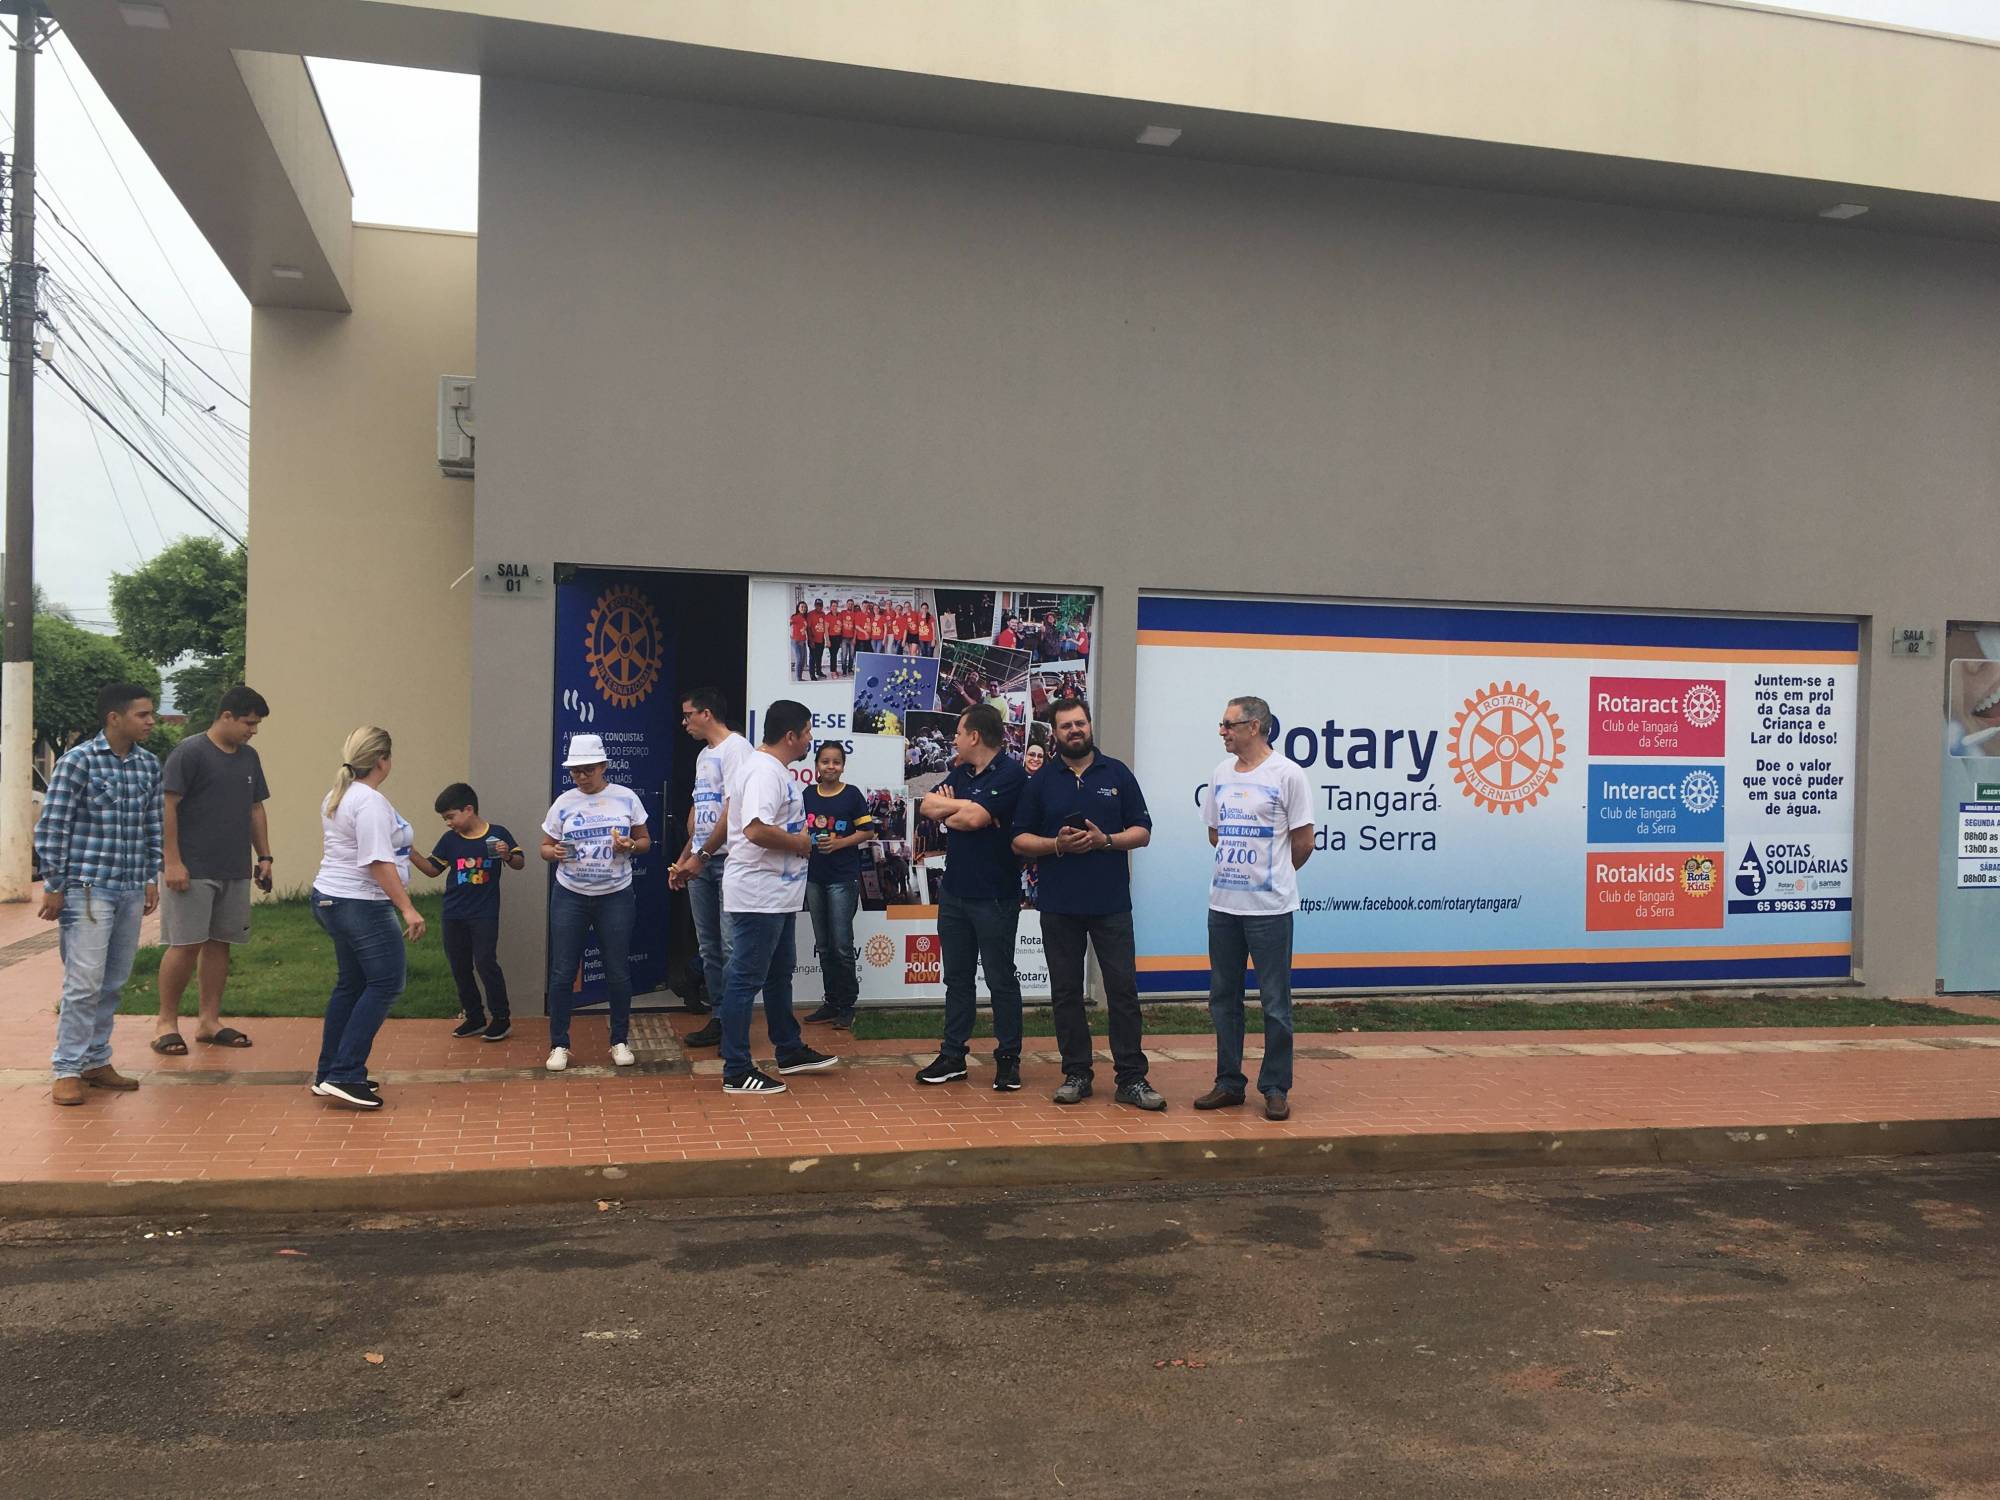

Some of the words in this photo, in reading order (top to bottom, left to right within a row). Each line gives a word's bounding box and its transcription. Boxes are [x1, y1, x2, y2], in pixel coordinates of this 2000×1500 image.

[498, 564, 529, 577] SALA
[506, 579, 521, 592] 01
[1904, 630, 1924, 641] SALA
[1908, 642, 1920, 653] 02
[1827, 677, 1835, 687] a
[1755, 688, 1778, 701] nós
[1784, 691, 1803, 701] em
[1809, 689, 1834, 703] prol
[1483, 696, 1532, 711] ROTARY
[1598, 693, 1678, 713] Rotaract
[1757, 703, 1773, 715] da
[1779, 703, 1810, 715] Casa
[1816, 703, 1831, 716] da
[812, 713, 846, 729] E-SE
[1763, 717, 1812, 731] Criança
[1818, 720, 1826, 730] e
[1602, 720, 1624, 732] Club
[1627, 720, 1639, 732] de
[1641, 720, 1678, 735] Tangará
[605, 732, 644, 743] CONQUISTAS
[1639, 735, 1651, 747] da
[1654, 736, 1678, 748] Serra
[1751, 732, 1772, 744] Lar
[1777, 732, 1793, 744] do
[1799, 732, 1838, 744] Idoso!
[622, 746, 648, 757] ESFORÇO
[1756, 759, 1781, 771] Doe
[1786, 762, 1794, 771] o
[1800, 759, 1832, 771] valor
[1466, 769, 1548, 800] INTERNATIONAL
[1743, 776, 1767, 788] que
[1772, 774, 1803, 786] você
[1808, 773, 1844, 788] puder
[1603, 781, 1676, 800] Interact
[1748, 791, 1768, 801] em
[1774, 791, 1796, 801] sua
[1802, 789, 1838, 801] conta
[1321, 783, 1438, 818] Tangará
[1600, 807, 1622, 819] Club
[1625, 807, 1637, 819] de
[1639, 806, 1677, 822] Tangará
[1765, 803, 1781, 815] de
[1786, 802, 1821, 818] água.
[1636, 822, 1649, 834] da
[1652, 822, 1676, 834] Serra
[1964, 819, 1995, 827] SEGUNDA
[1314, 825, 1345, 851] da
[1359, 825, 1437, 852] Serra
[1964, 832, 1988, 841] 08h00
[1989, 833, 1998, 841] as
[1765, 844, 1811, 858] GOTAS
[1964, 845, 1987, 854] 13h00
[1989, 846, 1998, 854] as
[1766, 855, 1848, 875] SOLIDÁRIAS
[1980, 862, 2000, 872] SÁBAD
[1596, 863, 1675, 883] Rotakids
[1687, 872, 1710, 881] Rota
[1963, 874, 1987, 883] 08h00
[1988, 875, 1997, 883] as
[1687, 882, 1710, 891] Kids
[1599, 890, 1621, 903] Club
[1624, 890, 1636, 902] de
[1638, 889, 1675, 905] Tangará
[1298, 895, 1522, 914] ttps://www.facebook.com/rotarytangara/
[1757, 901, 1771, 912] 65
[1774, 900, 1807, 911] 99636
[1810, 899, 1836, 910] 3579
[1635, 905, 1648, 917] da
[1651, 905, 1674, 917] Serra
[1020, 935, 1043, 945] Rota
[585, 947, 600, 957] Conh
[910, 953, 936, 963] END
[905, 962, 940, 973] POLIO
[908, 971, 937, 982] NOW
[1015, 972, 1048, 983] Rotary
